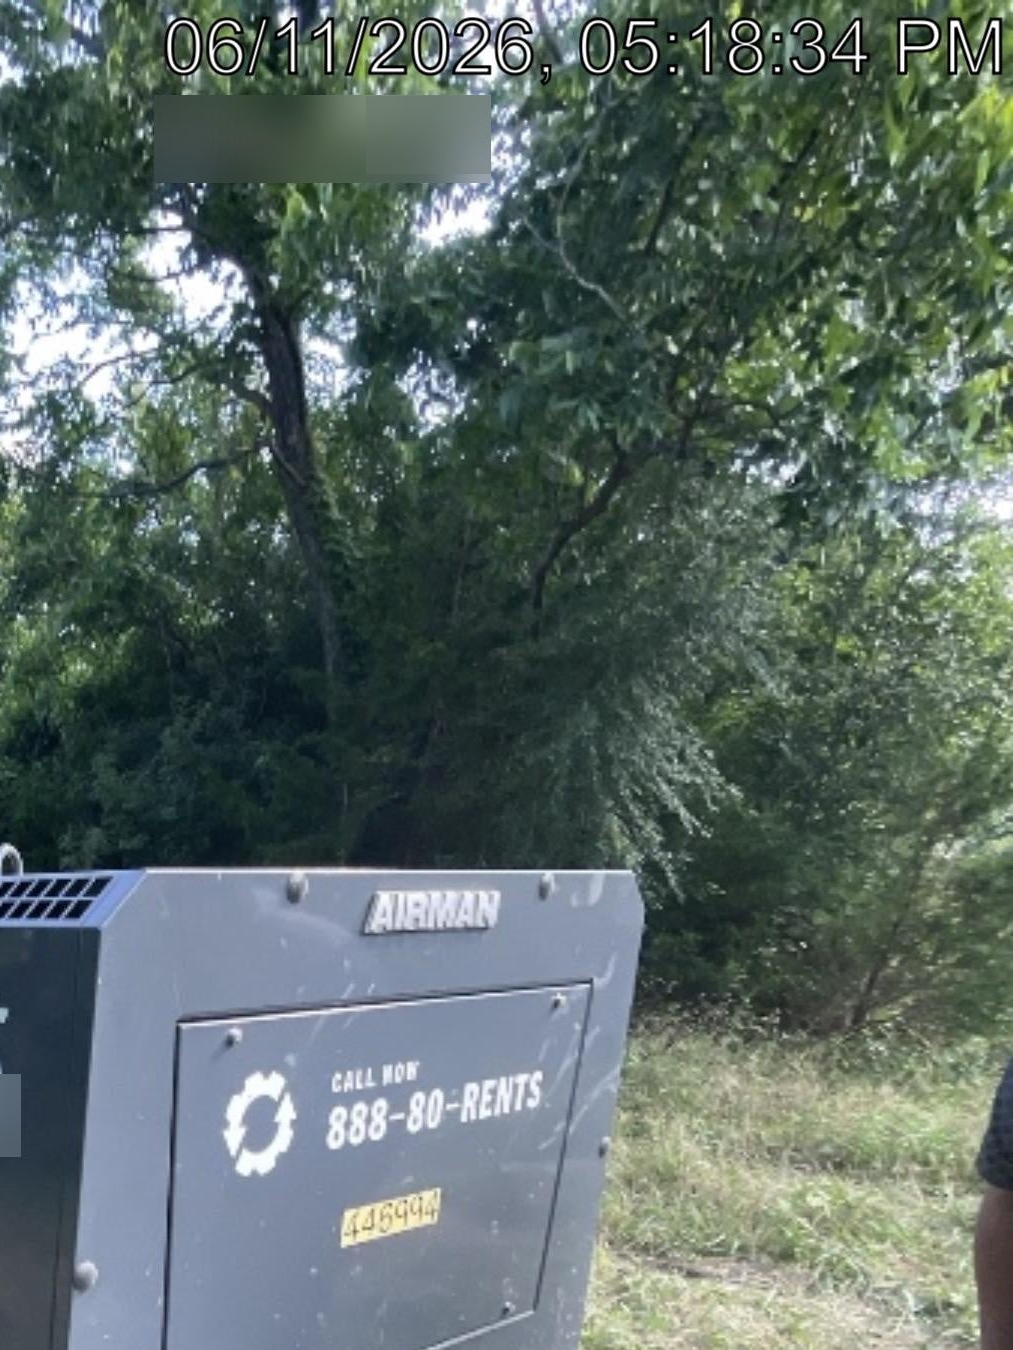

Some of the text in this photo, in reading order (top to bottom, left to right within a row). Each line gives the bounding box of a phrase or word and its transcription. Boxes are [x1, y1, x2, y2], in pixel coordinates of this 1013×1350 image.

[364, 890, 500, 934] AIRMAN
[331, 1060, 420, 1093] CALL NOW
[326, 1070, 544, 1150] 888-80-RENTS
